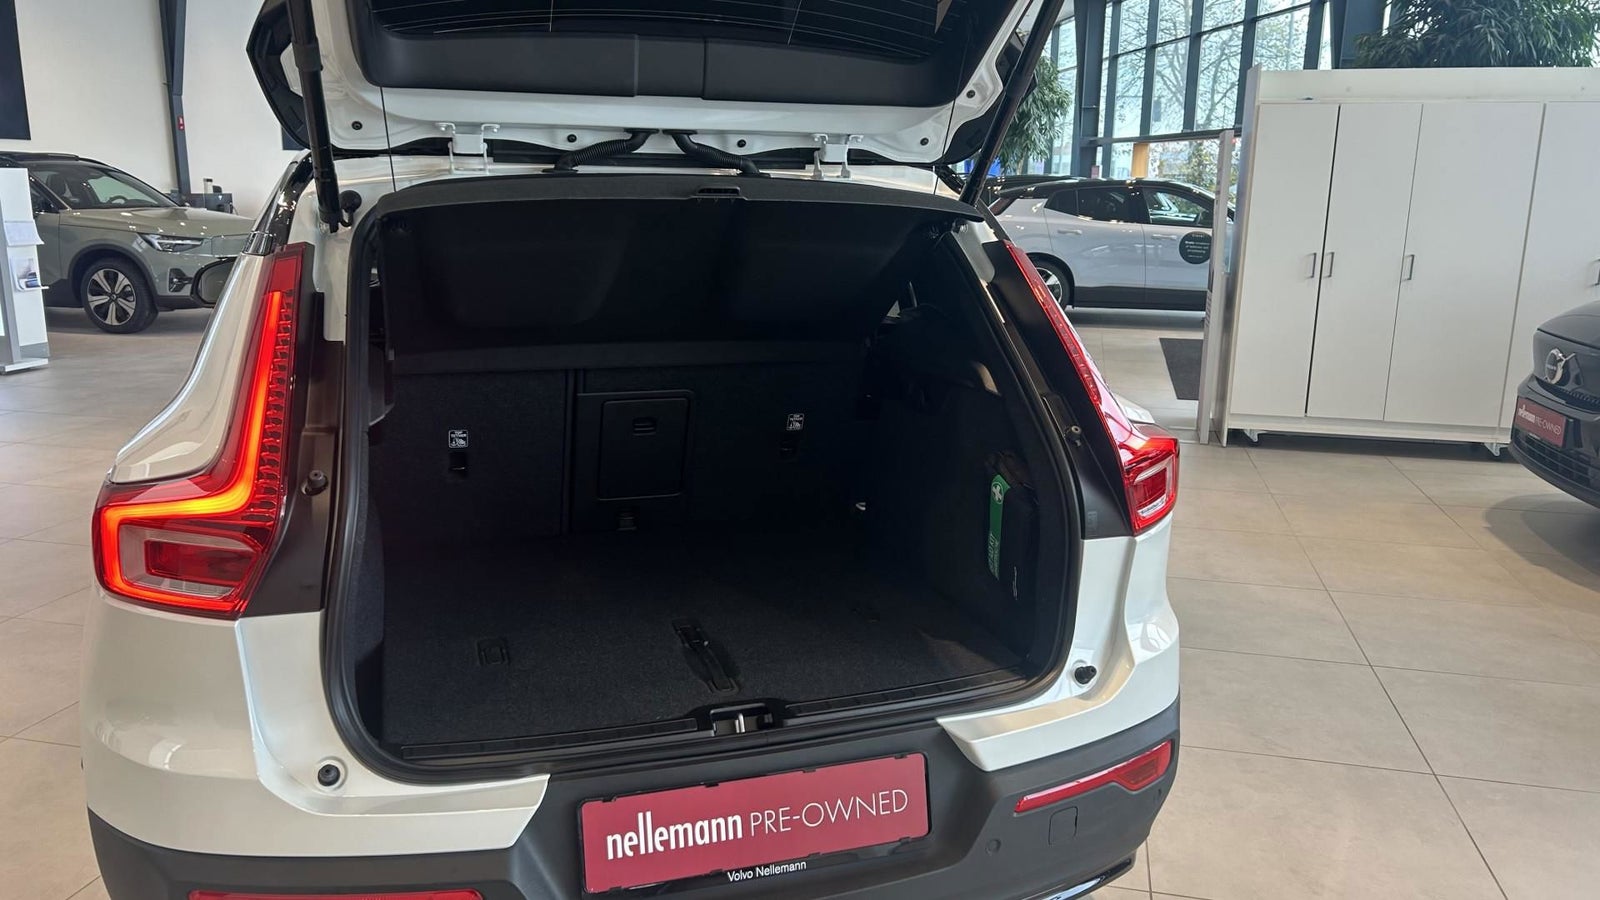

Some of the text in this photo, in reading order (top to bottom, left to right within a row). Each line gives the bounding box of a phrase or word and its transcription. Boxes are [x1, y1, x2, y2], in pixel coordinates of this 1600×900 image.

[606, 789, 908, 860] nellemann PRE-OWNED
[727, 860, 807, 882] Volvo Nellemann
